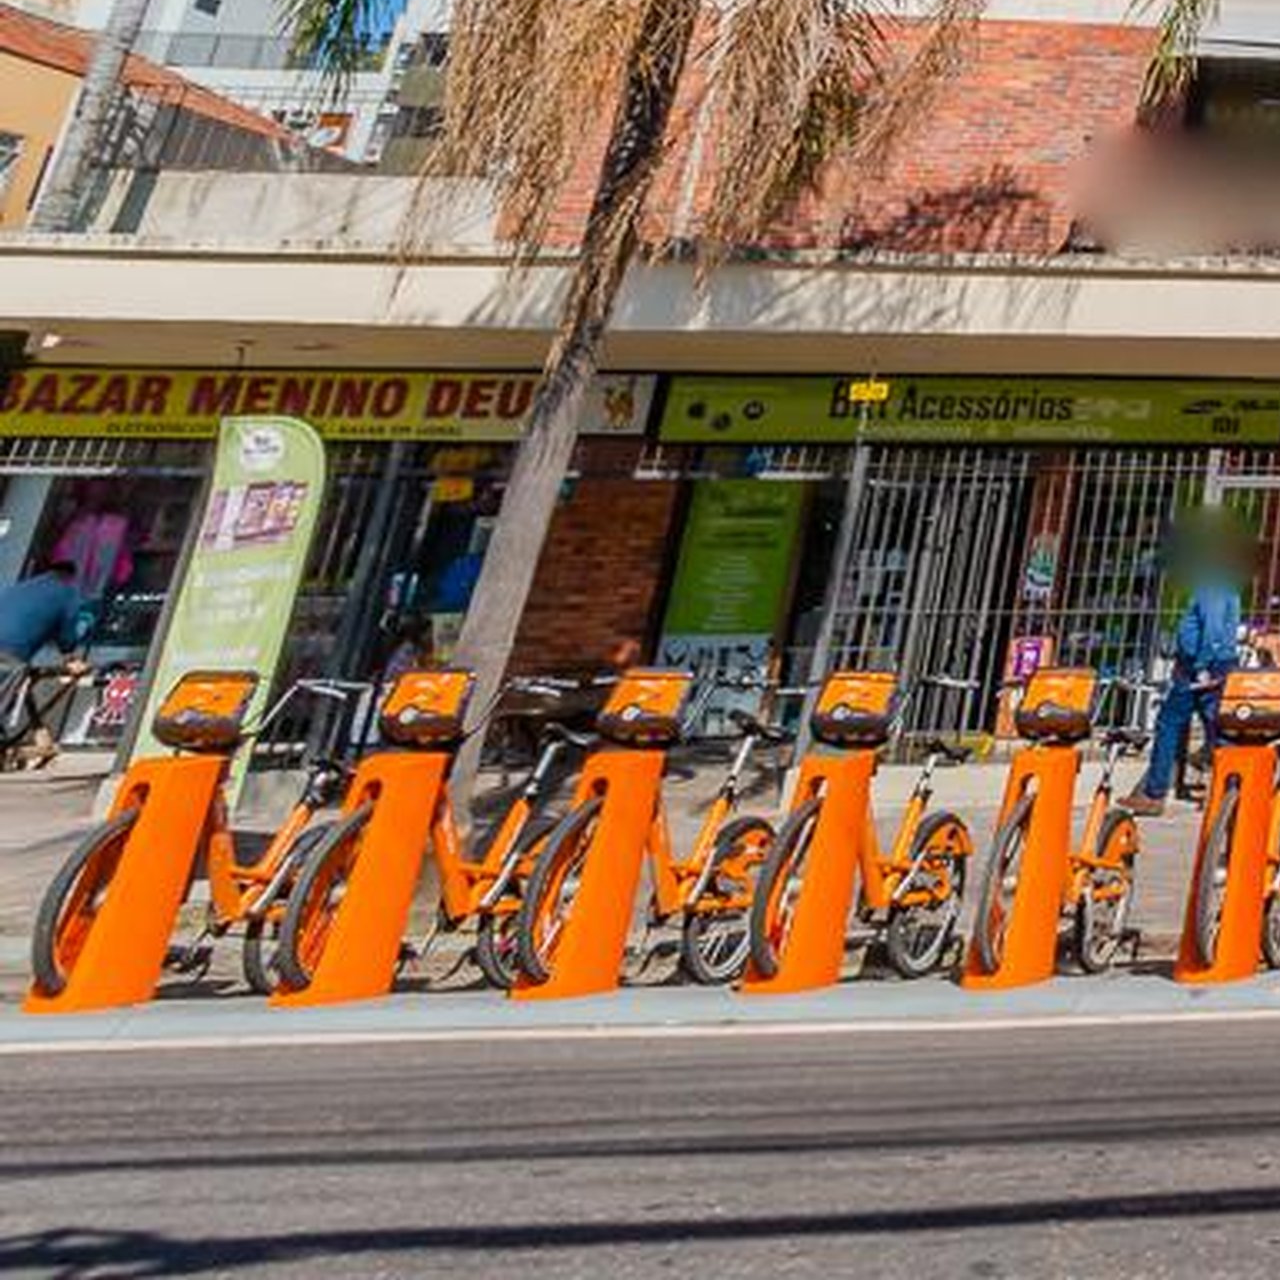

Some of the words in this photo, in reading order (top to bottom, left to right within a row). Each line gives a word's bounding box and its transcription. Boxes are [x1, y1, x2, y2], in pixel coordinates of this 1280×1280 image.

[0, 373, 172, 414] BAZAR
[187, 374, 409, 419] MENINO
[897, 381, 1076, 421] Acessórios
